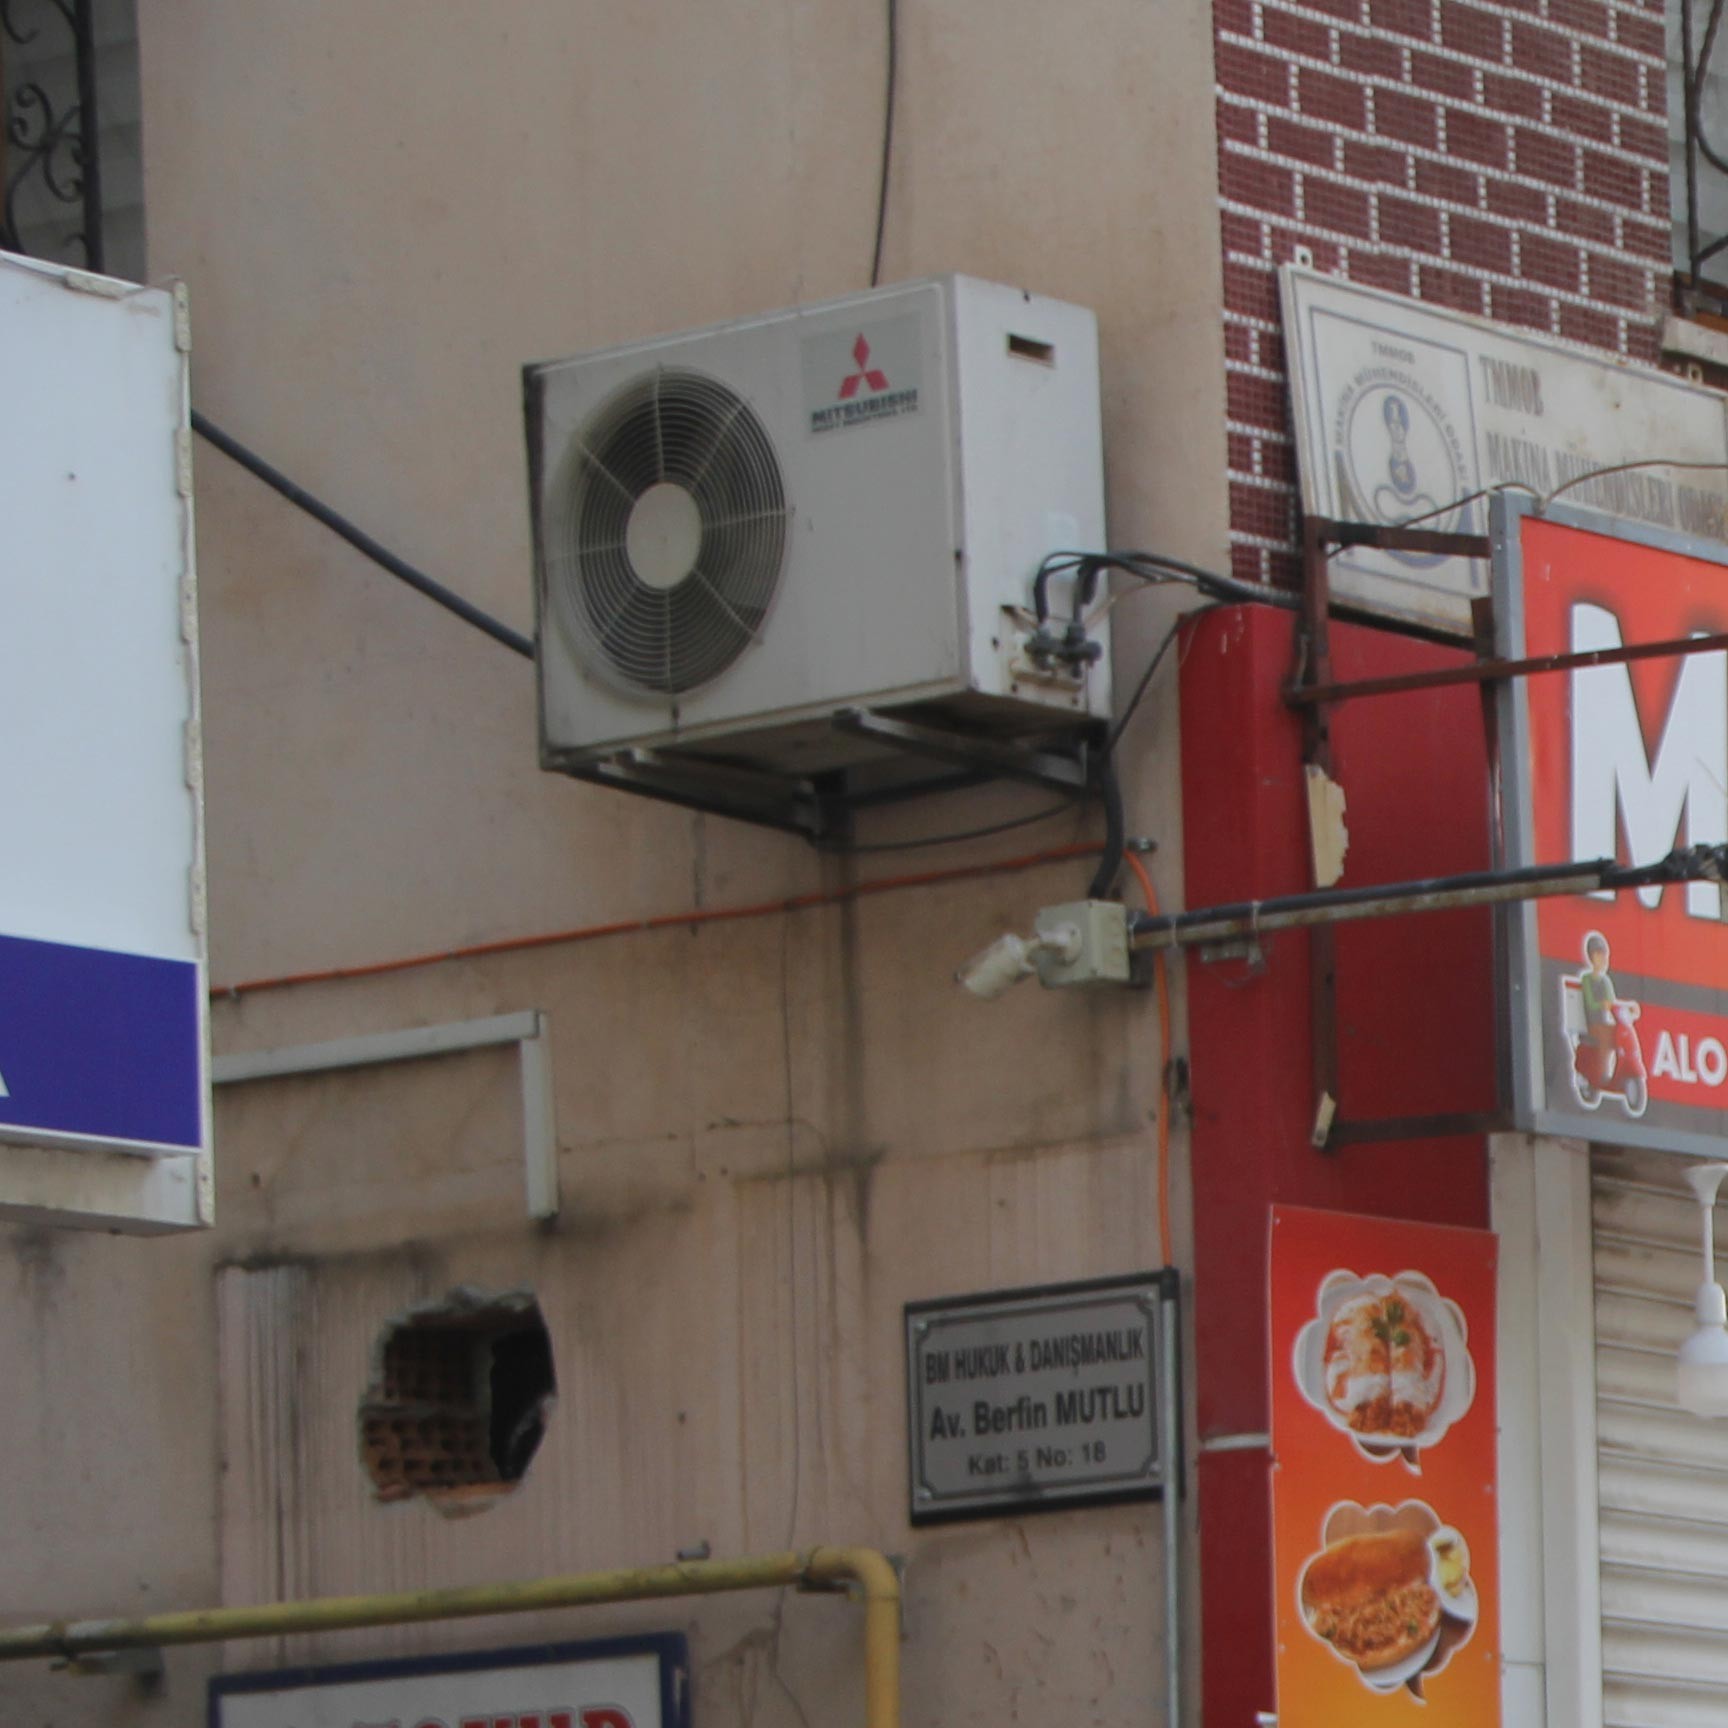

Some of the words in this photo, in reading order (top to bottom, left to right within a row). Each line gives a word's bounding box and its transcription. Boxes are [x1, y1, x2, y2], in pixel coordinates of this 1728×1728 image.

[811, 389, 918, 425] MITSUBISHI
[1652, 1027, 1728, 1086] ALO
[954, 1344, 1011, 1381] HUKUK
[1030, 1326, 1145, 1378] DANIŞMANLIK
[929, 1405, 967, 1441] Av.
[973, 1395, 1048, 1437] Berfin
[1055, 1383, 1146, 1426] MUTLU
[968, 1453, 1011, 1477] Kat:
[1017, 1450, 1031, 1472] 5
[1036, 1446, 1073, 1469] No:
